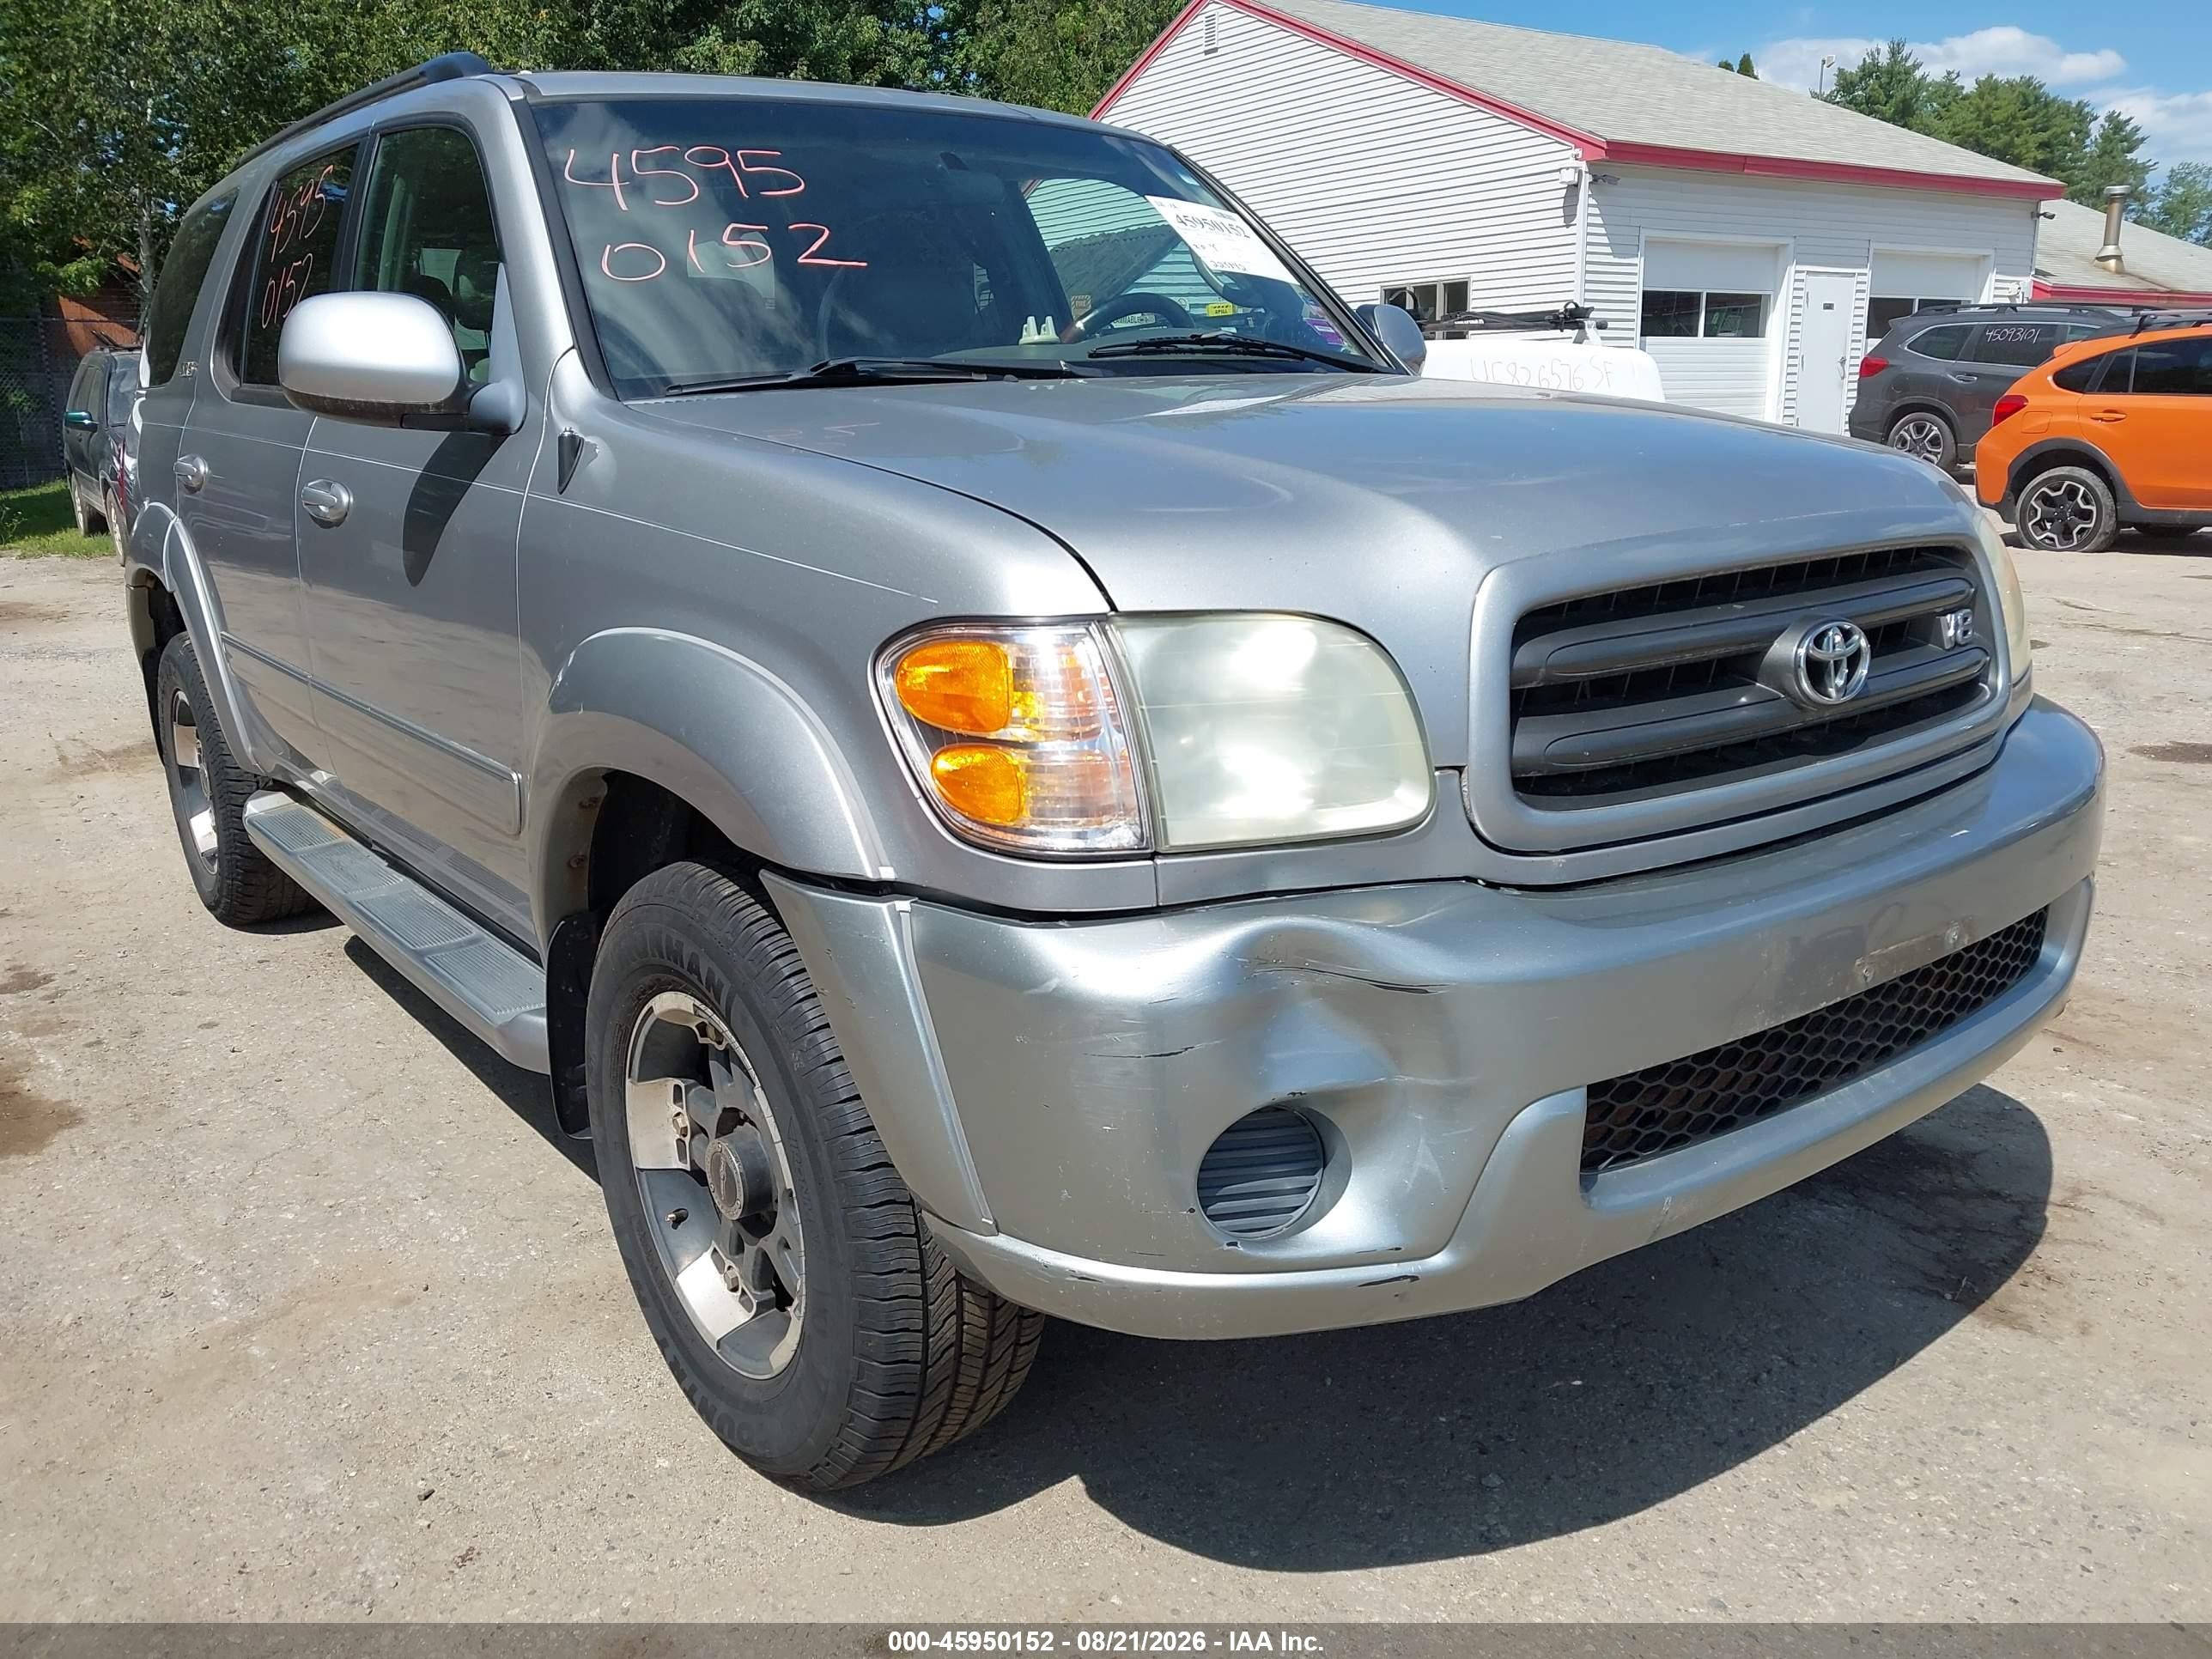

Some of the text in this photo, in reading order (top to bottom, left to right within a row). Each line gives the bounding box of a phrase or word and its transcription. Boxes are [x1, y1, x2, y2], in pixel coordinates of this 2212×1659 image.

[565, 145, 805, 211] 4595
[270, 164, 334, 264] 4595
[1176, 213, 1251, 239] 45950152
[602, 222, 868, 281] 0152
[1985, 327, 2042, 344] 45093101
[1936, 609, 1973, 650] V8
